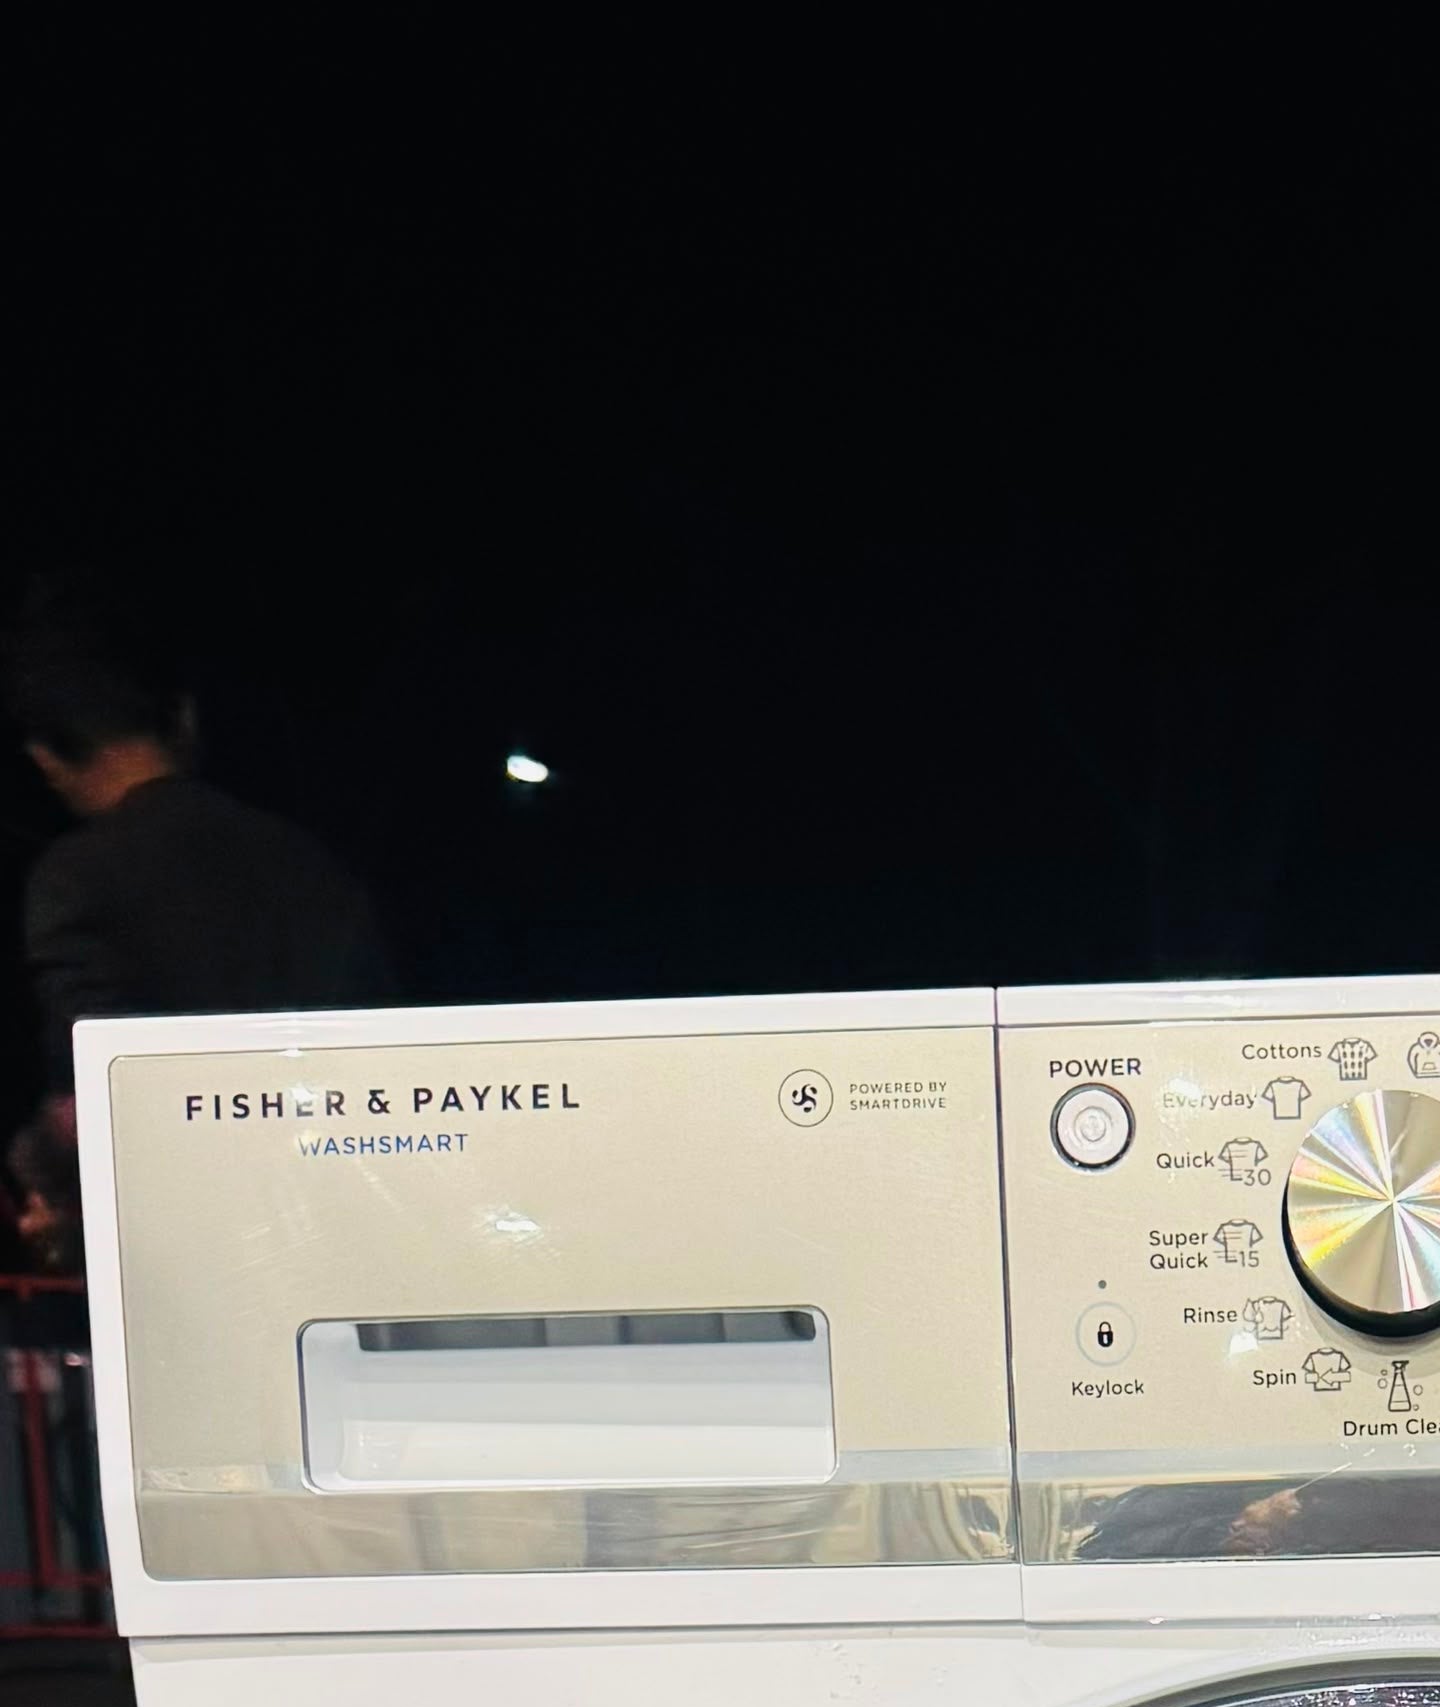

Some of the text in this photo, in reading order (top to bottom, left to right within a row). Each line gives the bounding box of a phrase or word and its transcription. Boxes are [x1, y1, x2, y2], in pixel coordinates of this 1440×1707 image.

[1242, 1042, 1322, 1060] Cottons
[1049, 1058, 1142, 1078] POWER
[850, 1081, 947, 1094] POWERED BY
[187, 1083, 580, 1120] FISHER & PAYKEL
[850, 1098, 947, 1110] SMARTDRIVE
[299, 1133, 468, 1156] WASHSMART
[1156, 1151, 1215, 1168] Quick
[1243, 1168, 1271, 1186] 30
[1149, 1229, 1209, 1251] Super
[1150, 1251, 1208, 1270] Quick
[1239, 1250, 1260, 1268] 15
[1183, 1306, 1238, 1324] Rinse
[1252, 1368, 1297, 1388] Spin
[1071, 1378, 1145, 1398] Keylock
[1342, 1418, 1399, 1436] Drum
